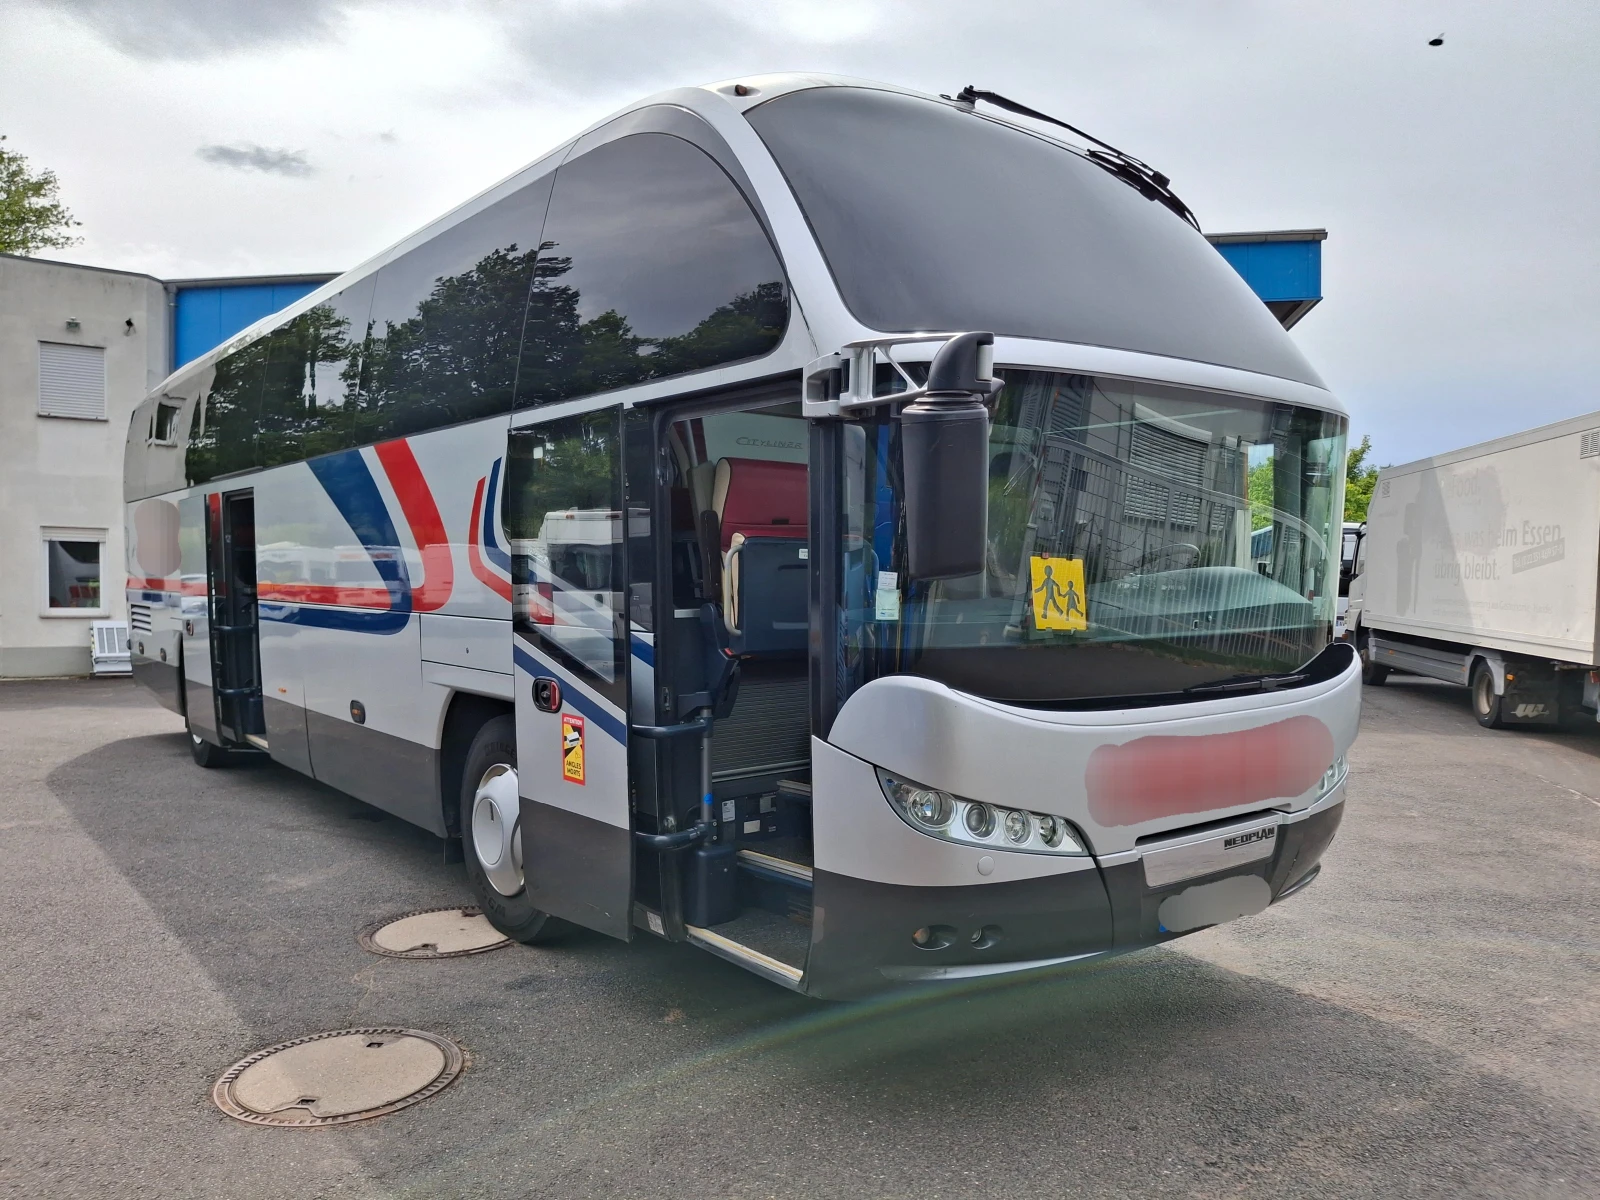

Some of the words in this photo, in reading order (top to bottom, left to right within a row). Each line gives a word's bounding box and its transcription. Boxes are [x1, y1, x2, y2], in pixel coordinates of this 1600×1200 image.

[563, 716, 584, 727] ATTENTION
[566, 760, 582, 770] ANGLES
[1224, 827, 1275, 850] NEOPLAN
